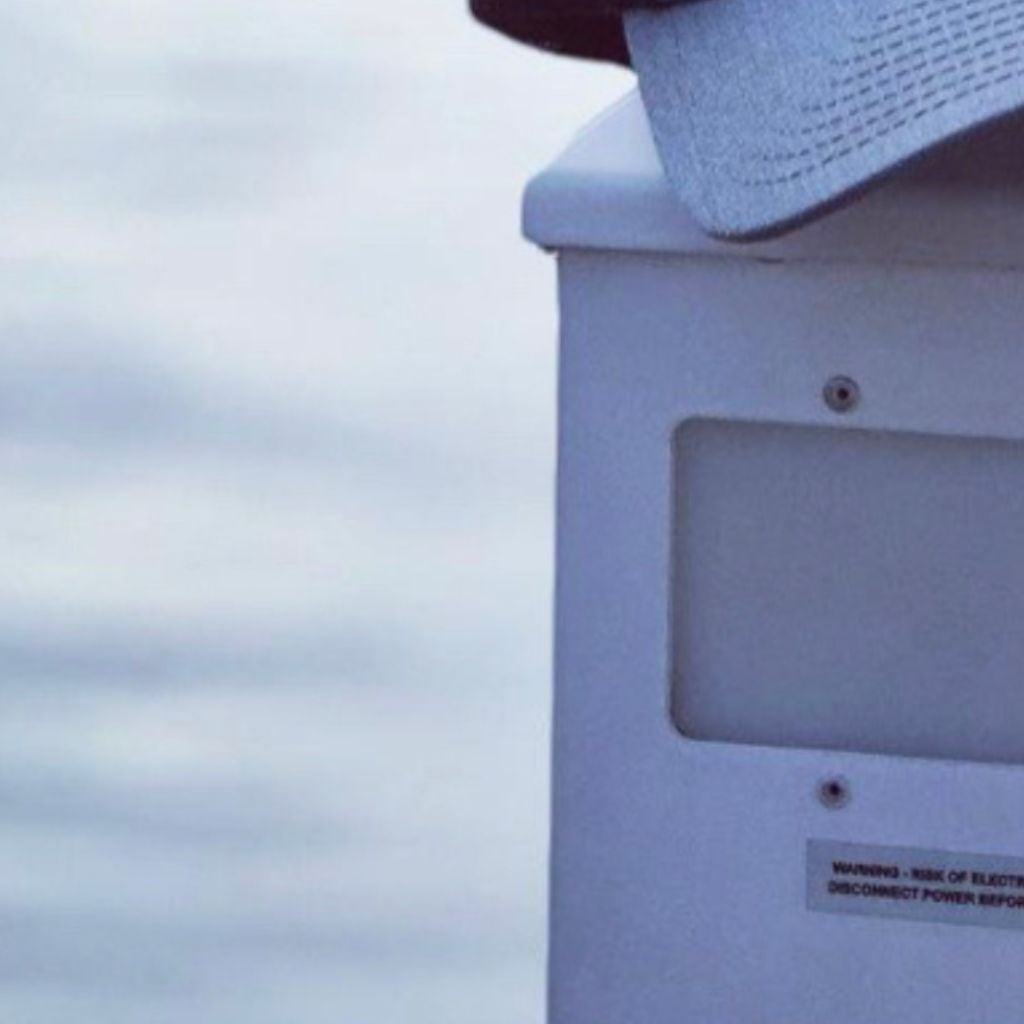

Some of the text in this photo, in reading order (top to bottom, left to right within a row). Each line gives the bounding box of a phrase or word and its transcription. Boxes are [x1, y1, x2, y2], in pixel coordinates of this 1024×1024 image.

[832, 861, 899, 879] WARNING
[911, 867, 945, 883] RISK
[948, 869, 968, 884] OF
[828, 879, 918, 900] DISCONNECT
[921, 886, 975, 906] POWER
